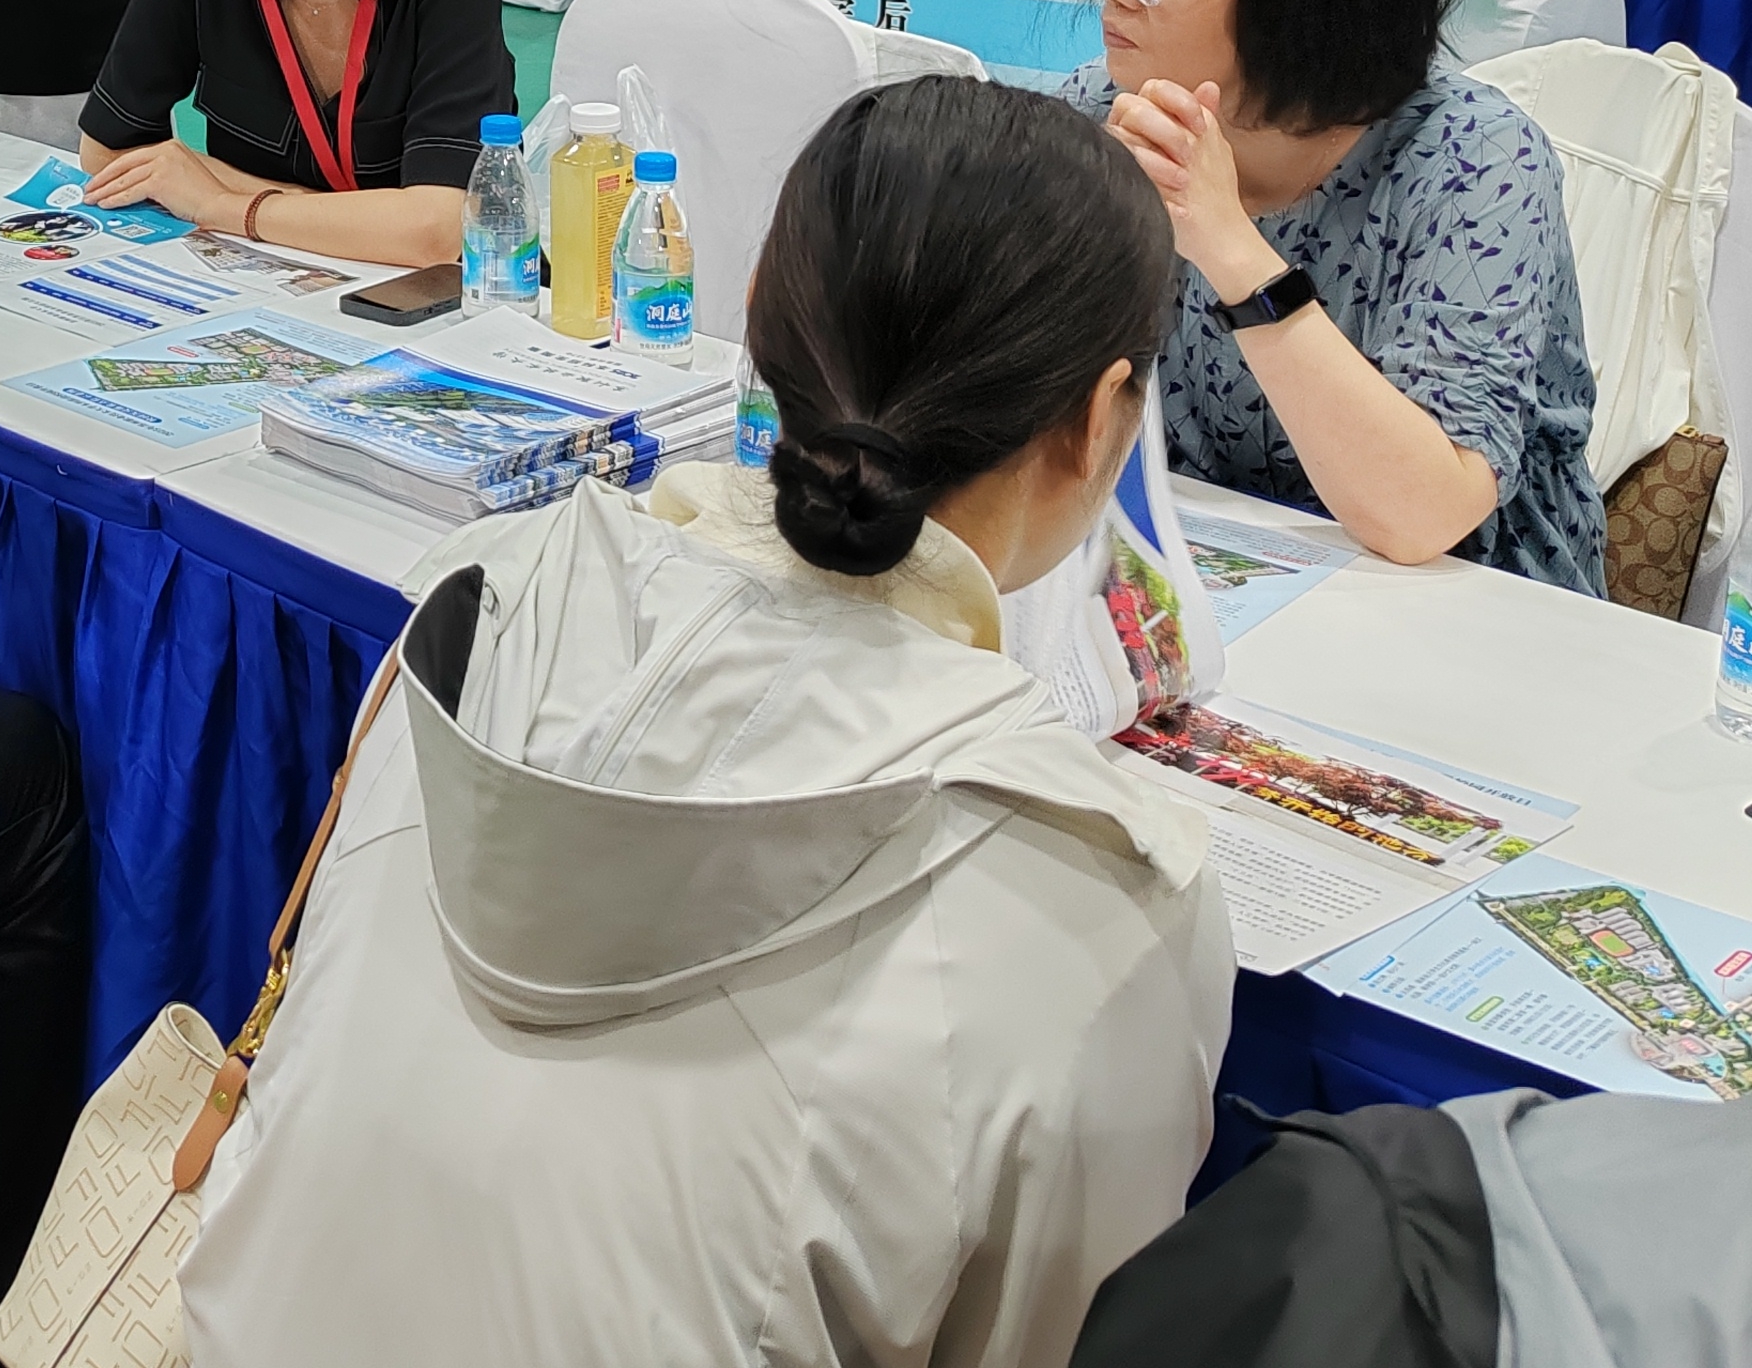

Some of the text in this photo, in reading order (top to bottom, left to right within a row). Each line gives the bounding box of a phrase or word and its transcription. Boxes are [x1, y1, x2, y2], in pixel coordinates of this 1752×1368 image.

[523, 258, 539, 275] 洞
[646, 302, 692, 322] 洞庭山
